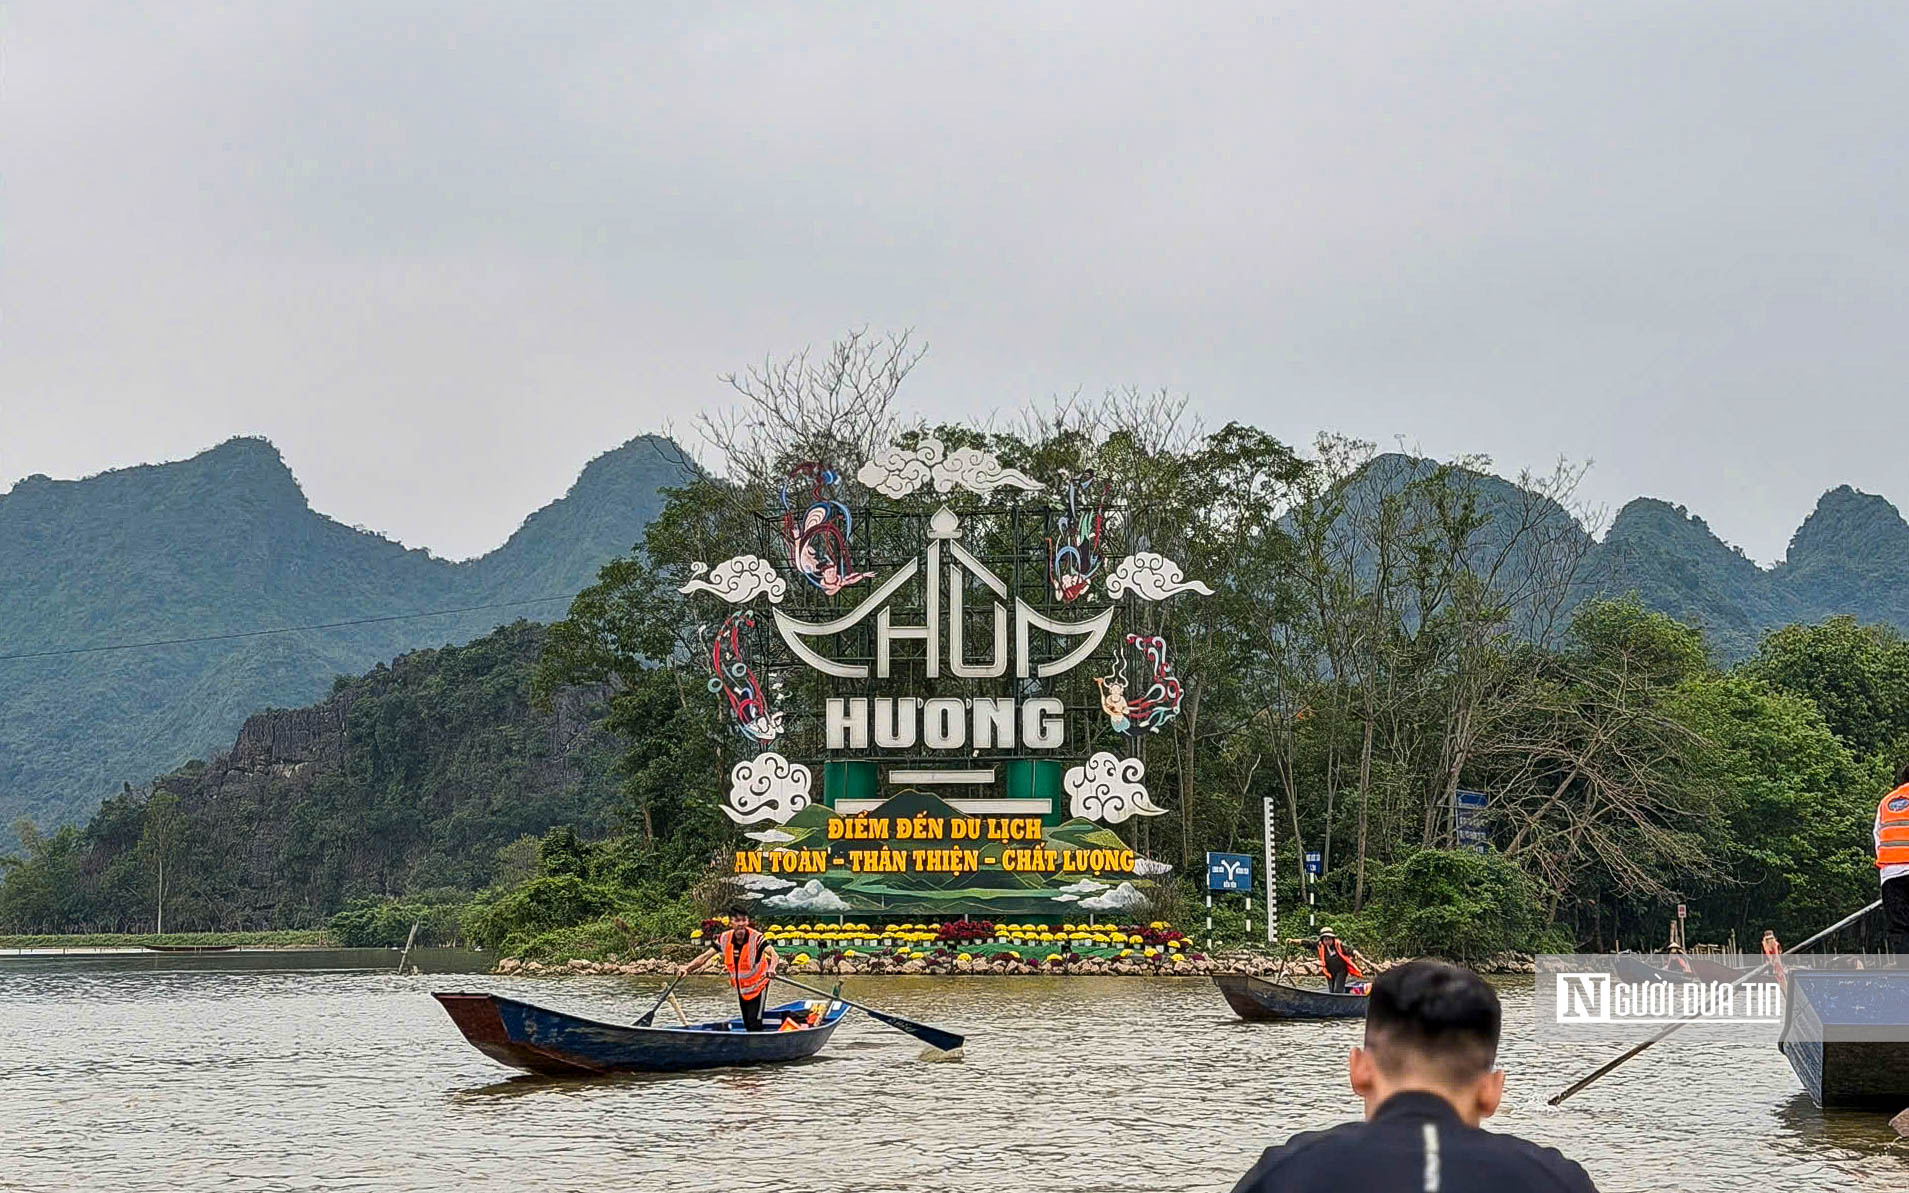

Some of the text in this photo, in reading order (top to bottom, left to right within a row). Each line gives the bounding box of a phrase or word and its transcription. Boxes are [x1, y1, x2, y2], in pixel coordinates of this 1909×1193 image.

[826, 698, 1064, 749] HƯƠNG
[827, 810, 1042, 843] ĐIỂM ĐẾN DU LỊCH
[734, 851, 762, 873] AN
[769, 846, 827, 873] TOÀN
[849, 845, 907, 873] THÂN
[913, 845, 979, 876] THIỆN
[1002, 842, 1057, 872] CHẤT
[1062, 848, 1136, 876] LƯỢNG
